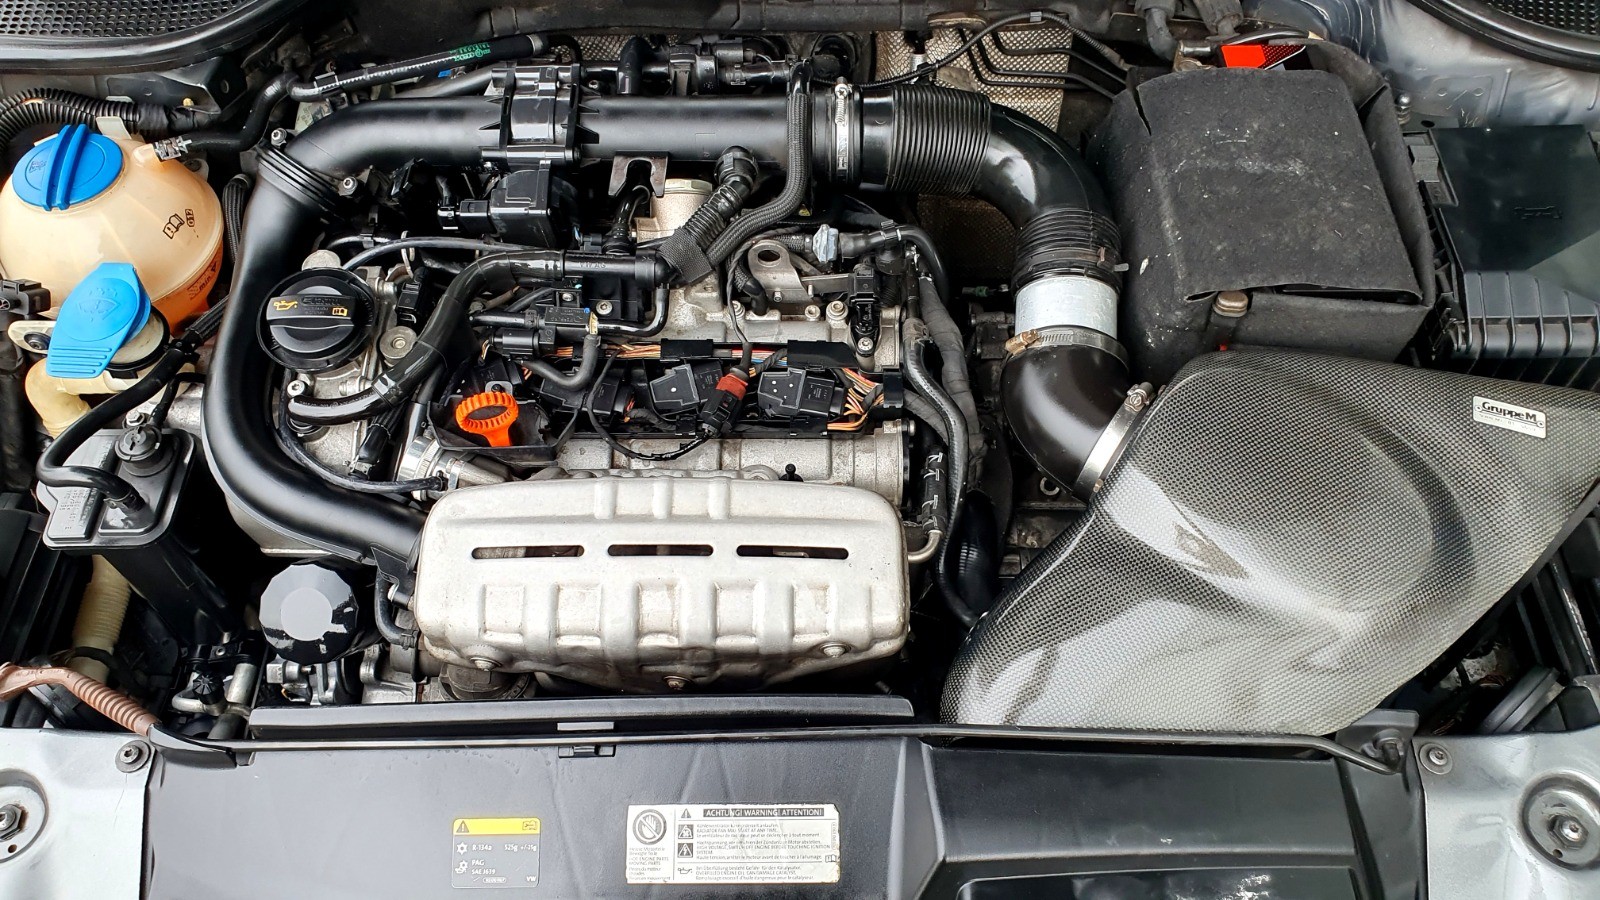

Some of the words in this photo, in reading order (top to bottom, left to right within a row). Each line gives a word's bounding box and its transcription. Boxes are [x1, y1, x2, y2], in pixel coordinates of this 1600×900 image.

[706, 809, 742, 817] ACHTUNG!
[744, 808, 780, 817] WARNING!
[781, 808, 822, 816] ATTENTION!
